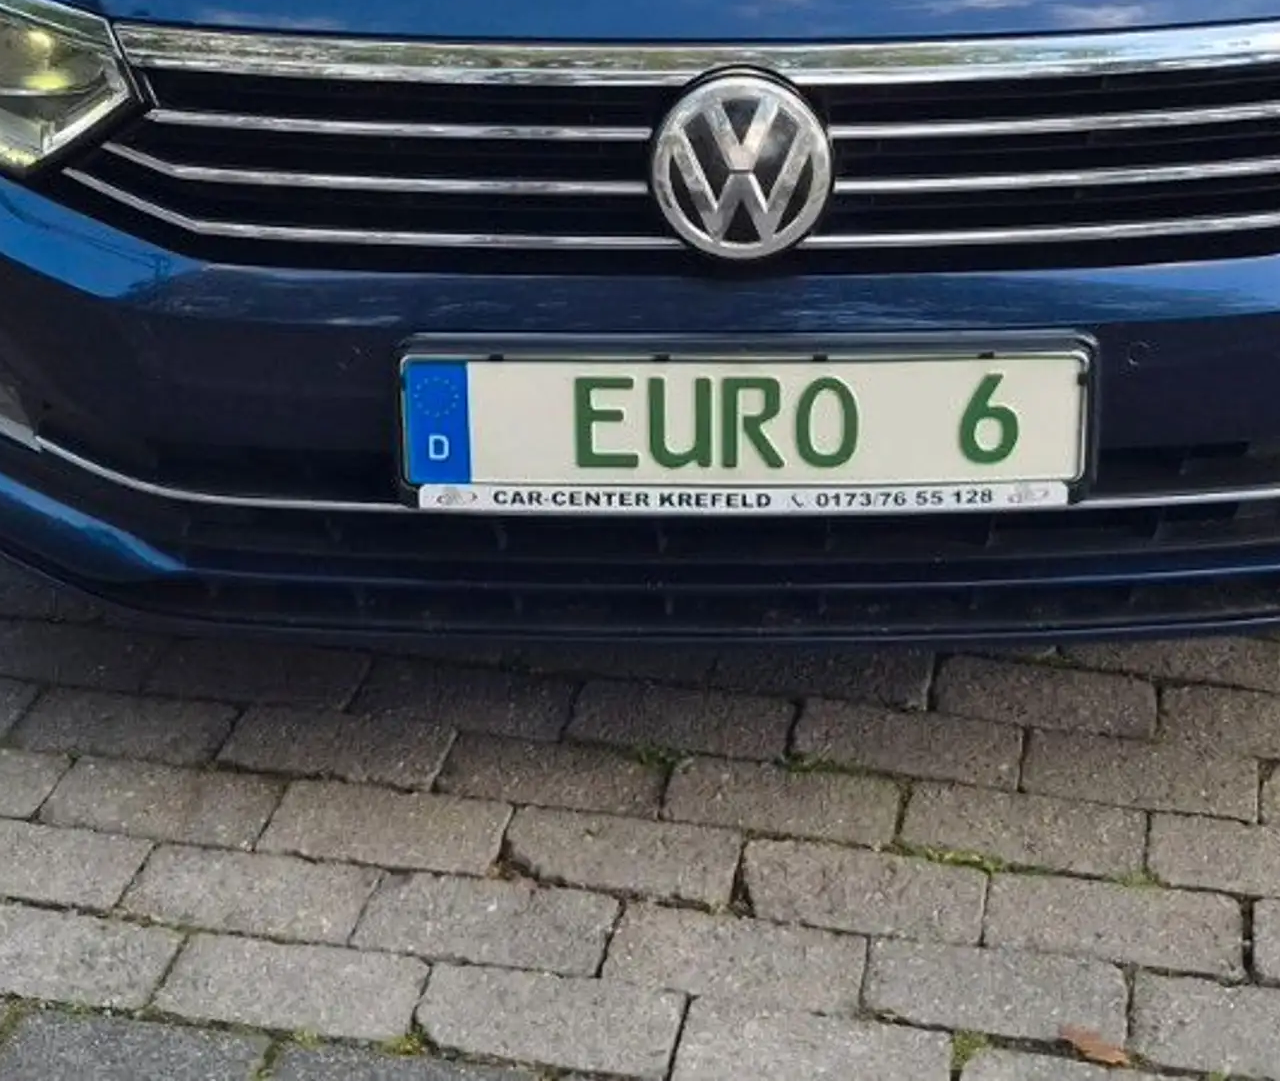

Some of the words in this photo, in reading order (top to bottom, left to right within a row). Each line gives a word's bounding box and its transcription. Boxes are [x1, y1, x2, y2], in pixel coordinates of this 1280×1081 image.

[575, 376, 859, 469] EURO
[959, 372, 1019, 465] 6
[428, 433, 450, 461] D
[492, 489, 651, 507] CAR-CENTER
[658, 491, 771, 509] KREFELD
[914, 490, 944, 507] 55
[953, 488, 993, 506] 128
